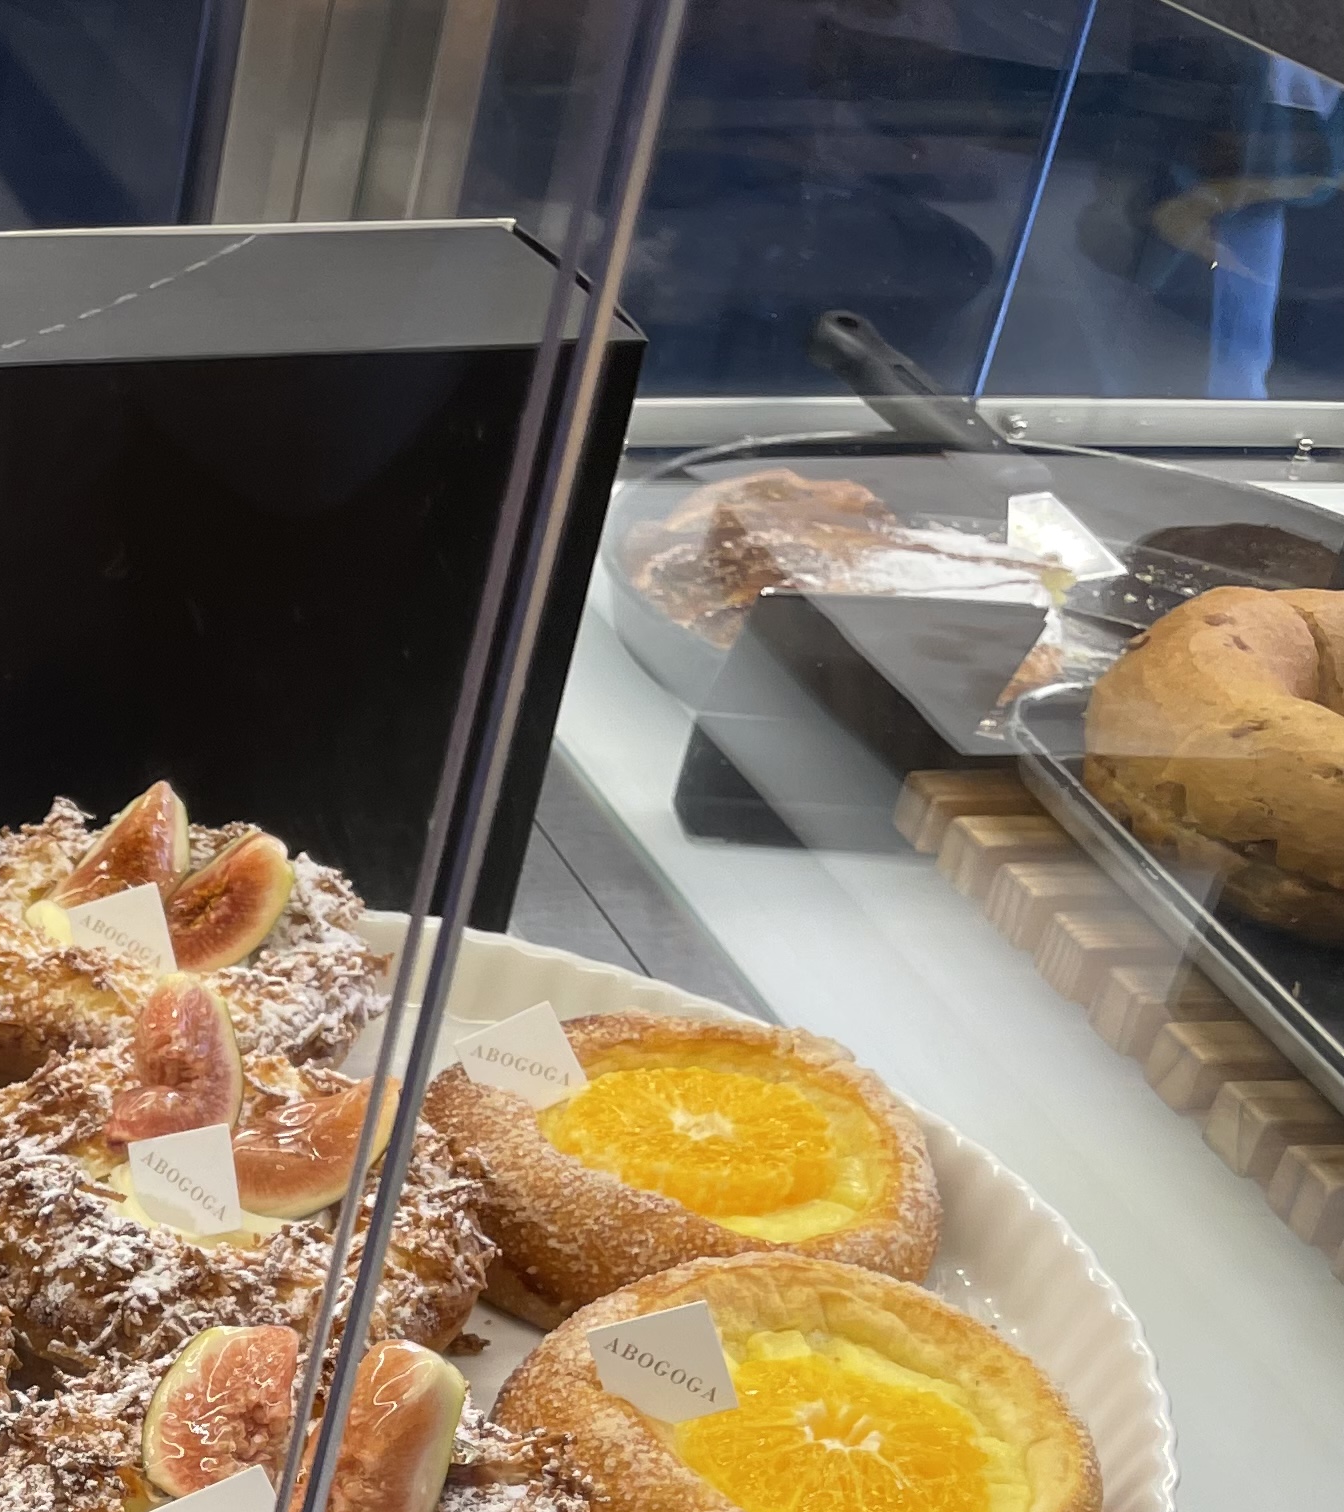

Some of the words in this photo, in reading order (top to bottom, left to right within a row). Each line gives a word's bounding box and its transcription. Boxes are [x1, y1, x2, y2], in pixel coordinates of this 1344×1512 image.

[80, 914, 162, 969] ABOGOGA
[470, 1044, 570, 1086] ABOGOGA
[140, 1151, 226, 1222] ABOGOGA
[603, 1337, 718, 1404] ABOGOGA
